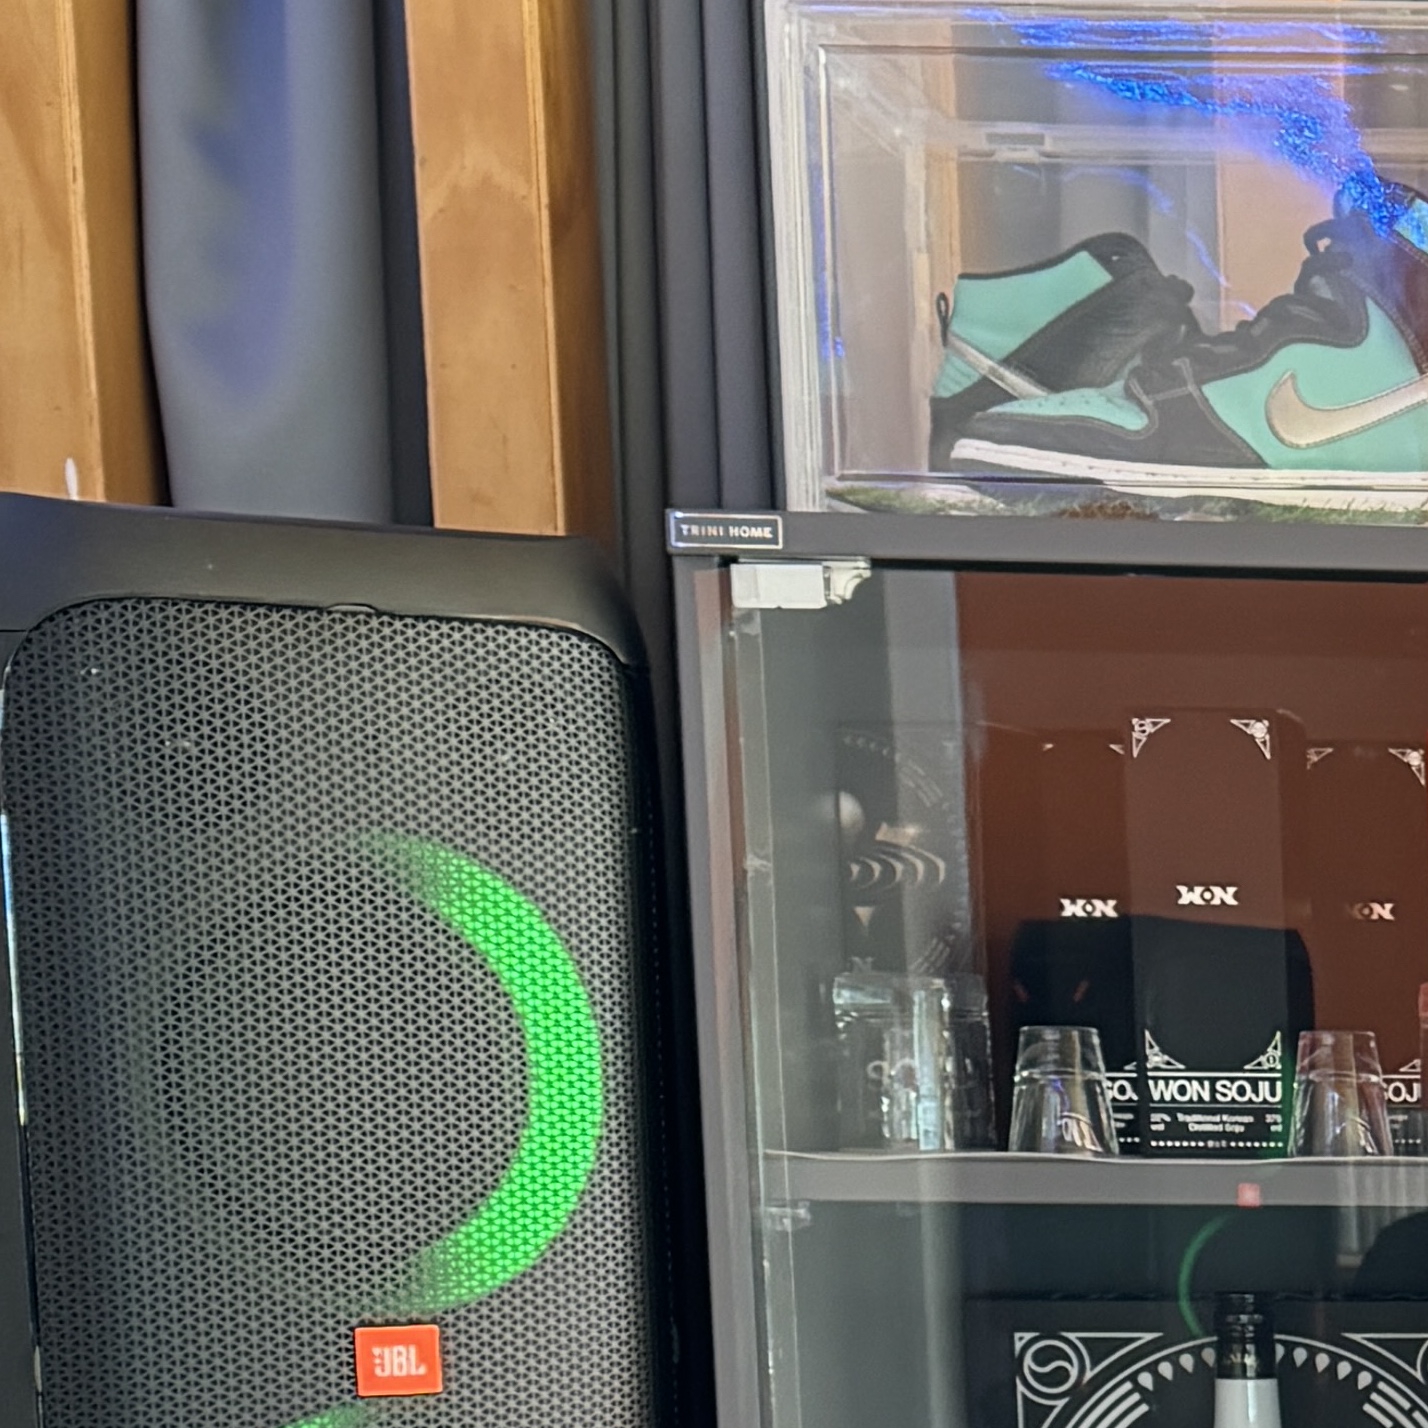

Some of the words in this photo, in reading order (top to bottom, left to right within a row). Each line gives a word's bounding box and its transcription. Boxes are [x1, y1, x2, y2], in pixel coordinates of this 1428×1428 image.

[680, 524, 724, 537] TRINI
[729, 525, 773, 539] HOME
[1147, 1079, 1210, 1102] WON
[1215, 1079, 1282, 1103] SOJU
[372, 1344, 428, 1378] JBL
